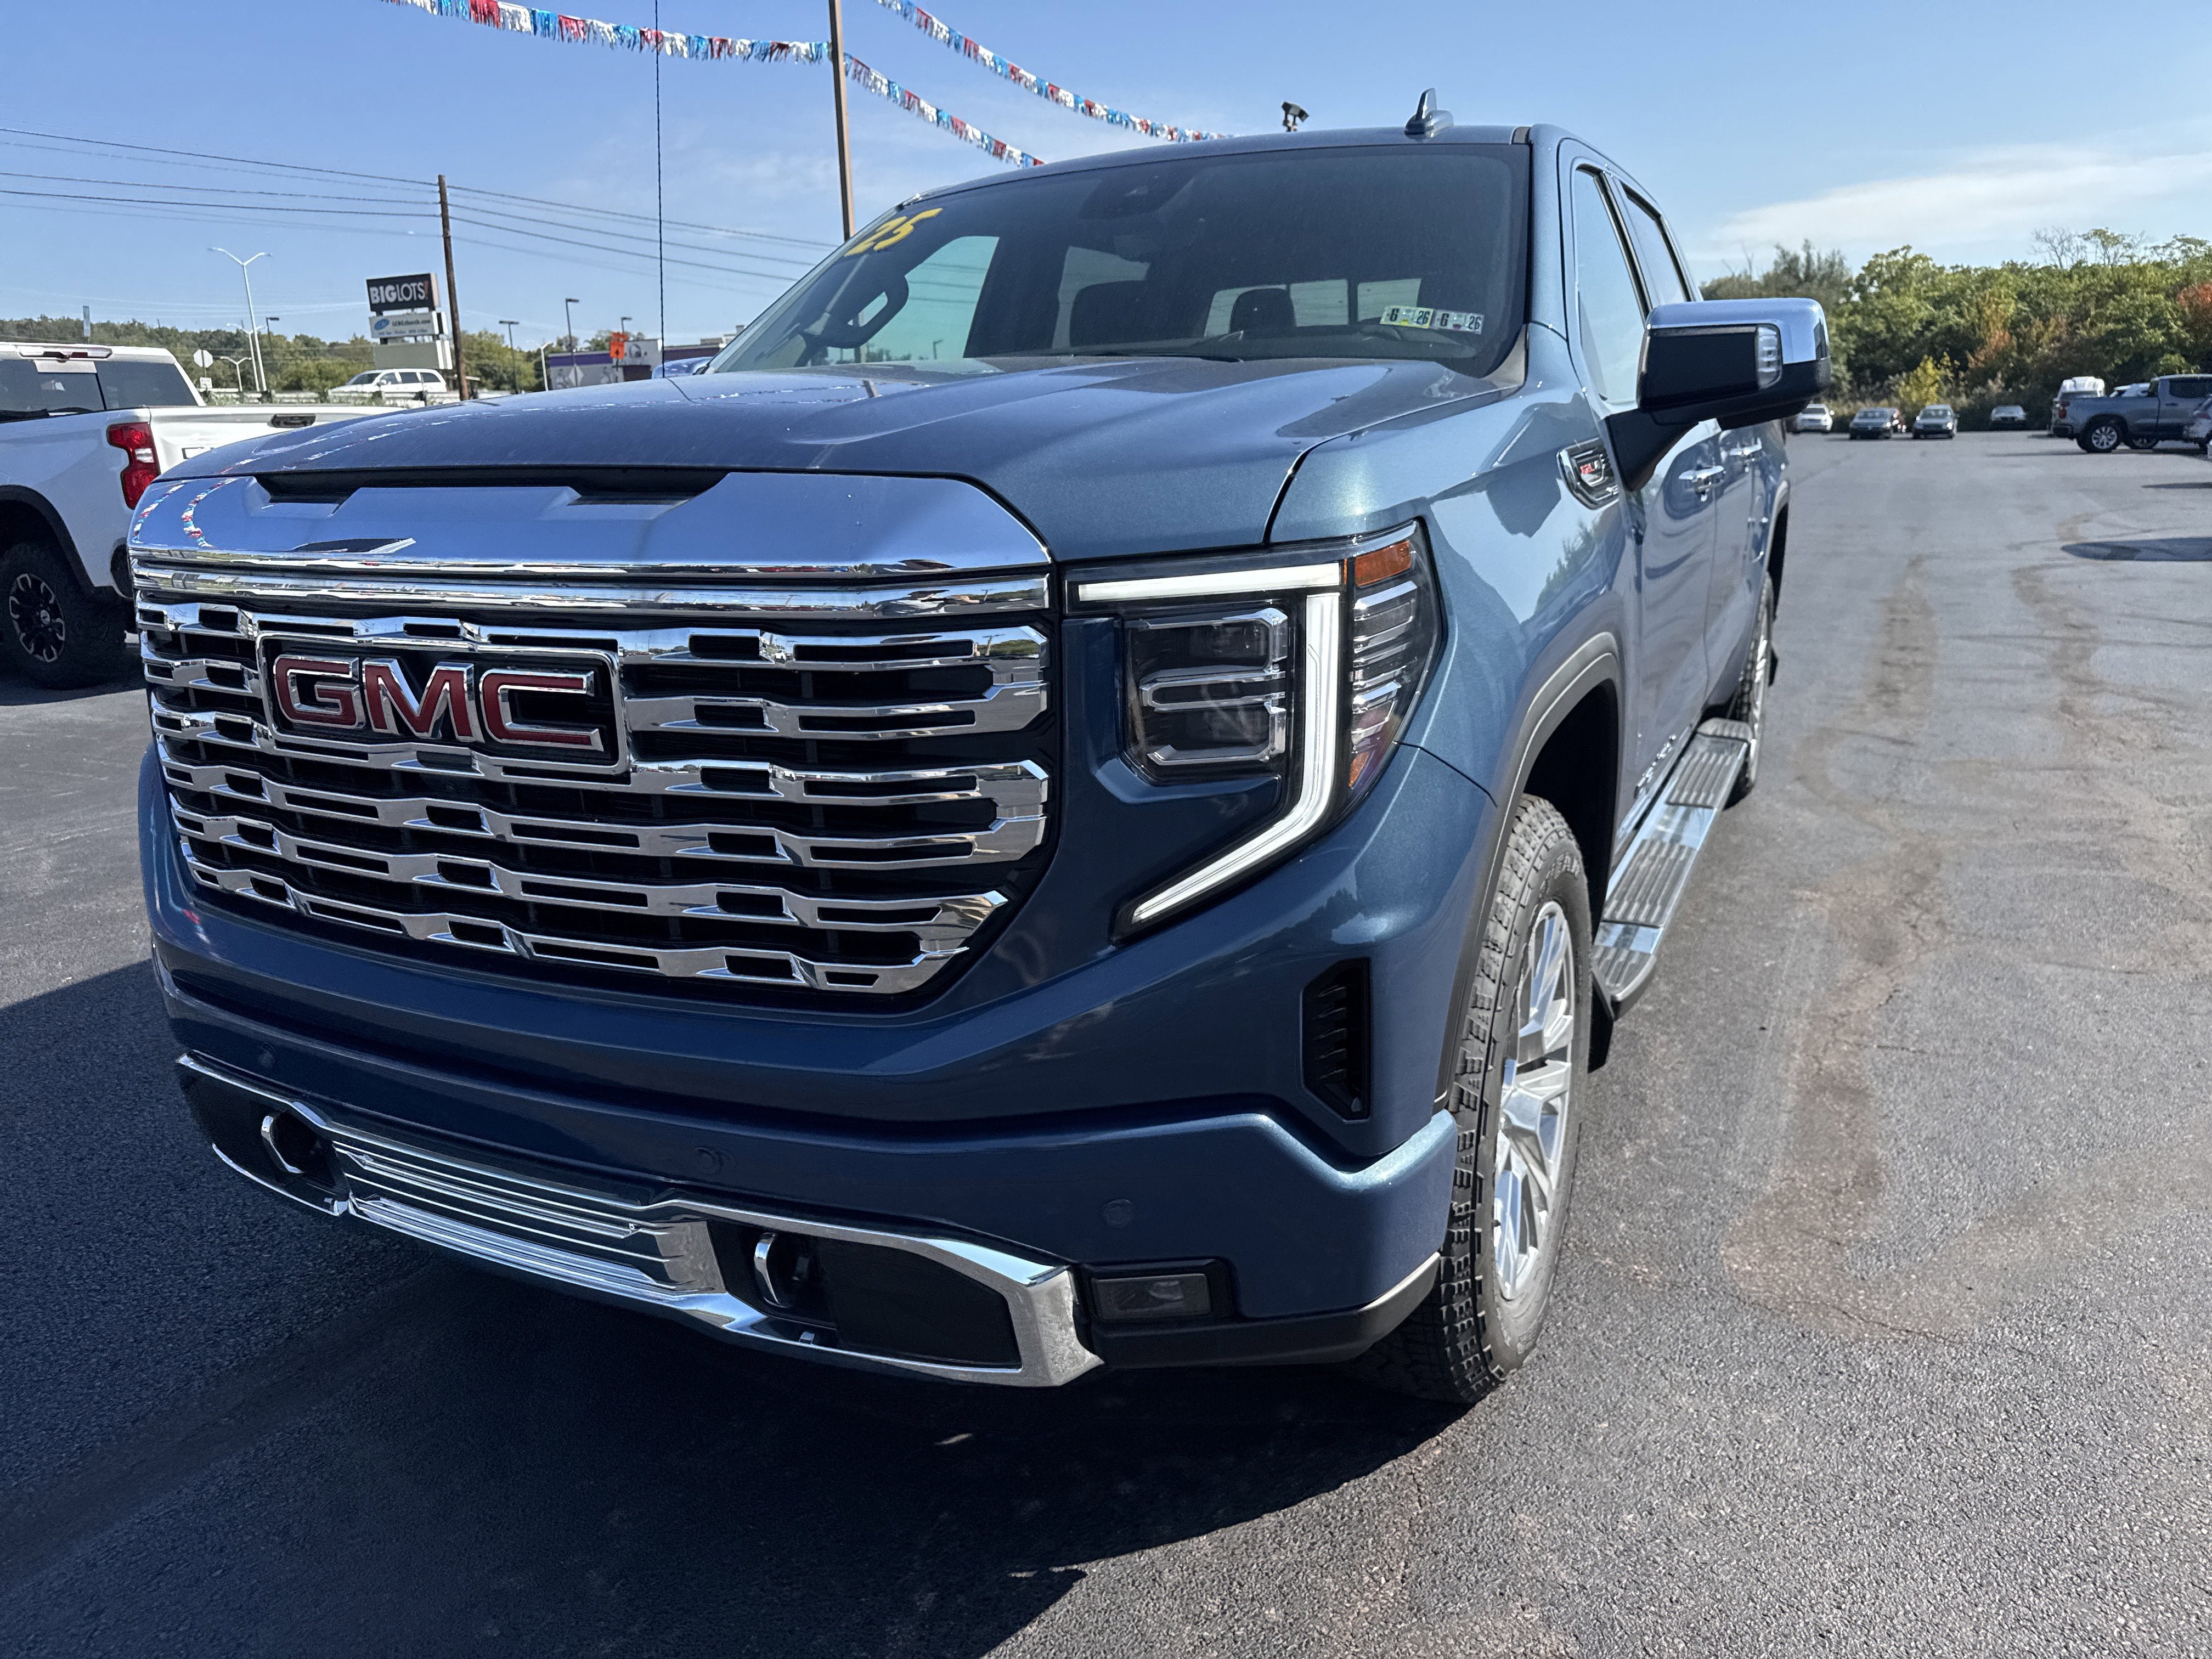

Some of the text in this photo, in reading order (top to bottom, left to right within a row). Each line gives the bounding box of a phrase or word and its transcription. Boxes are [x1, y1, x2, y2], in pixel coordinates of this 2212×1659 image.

[844, 208, 943, 257] 25
[1389, 308, 1431, 325] 6 26
[1468, 315, 1481, 330] 26
[274, 653, 603, 752] GMC
